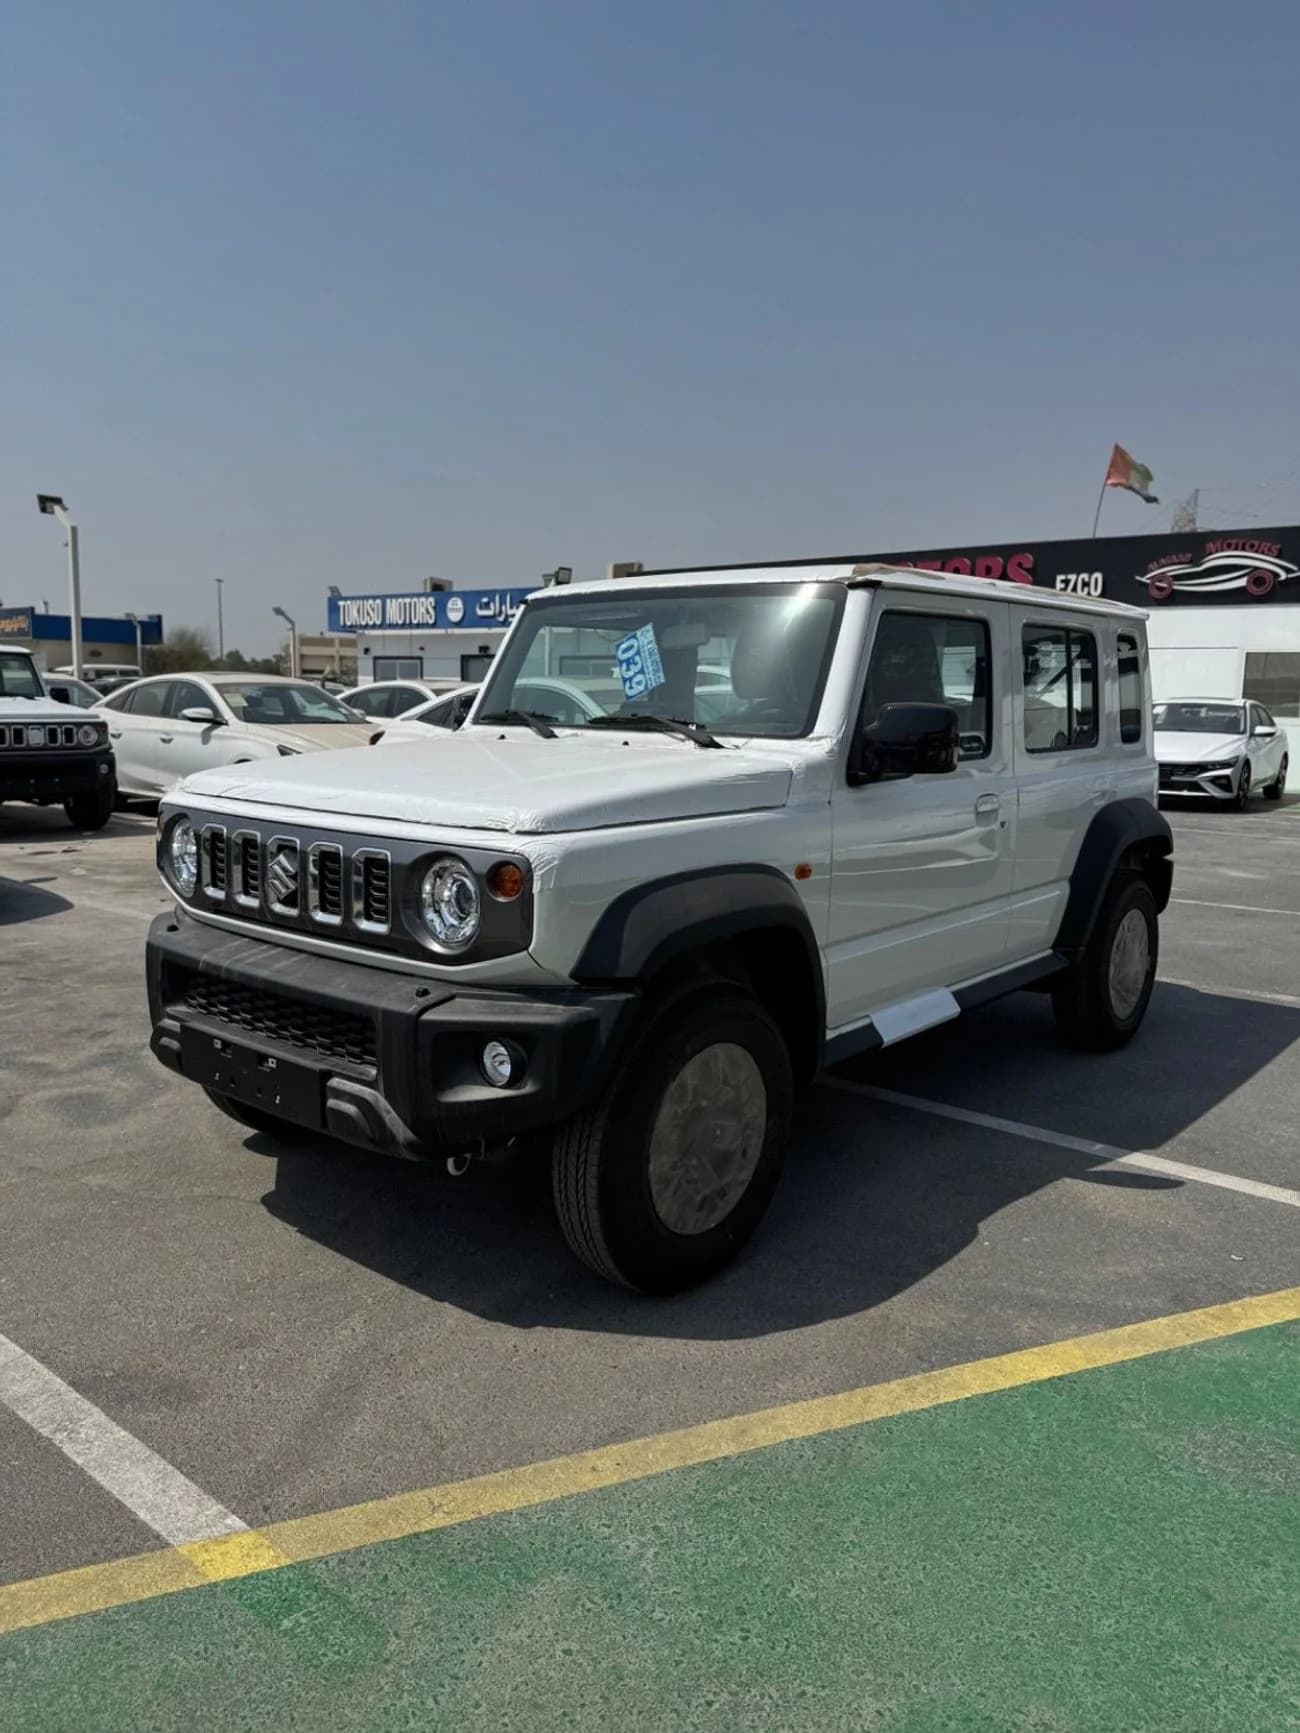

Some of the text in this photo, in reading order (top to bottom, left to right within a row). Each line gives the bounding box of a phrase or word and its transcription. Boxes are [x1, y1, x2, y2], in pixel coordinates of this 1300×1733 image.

[1055, 571, 1104, 597] EZCO
[338, 599, 382, 626] TOKUSO
[386, 597, 435, 625] MOTORS
[617, 638, 646, 697] 039
